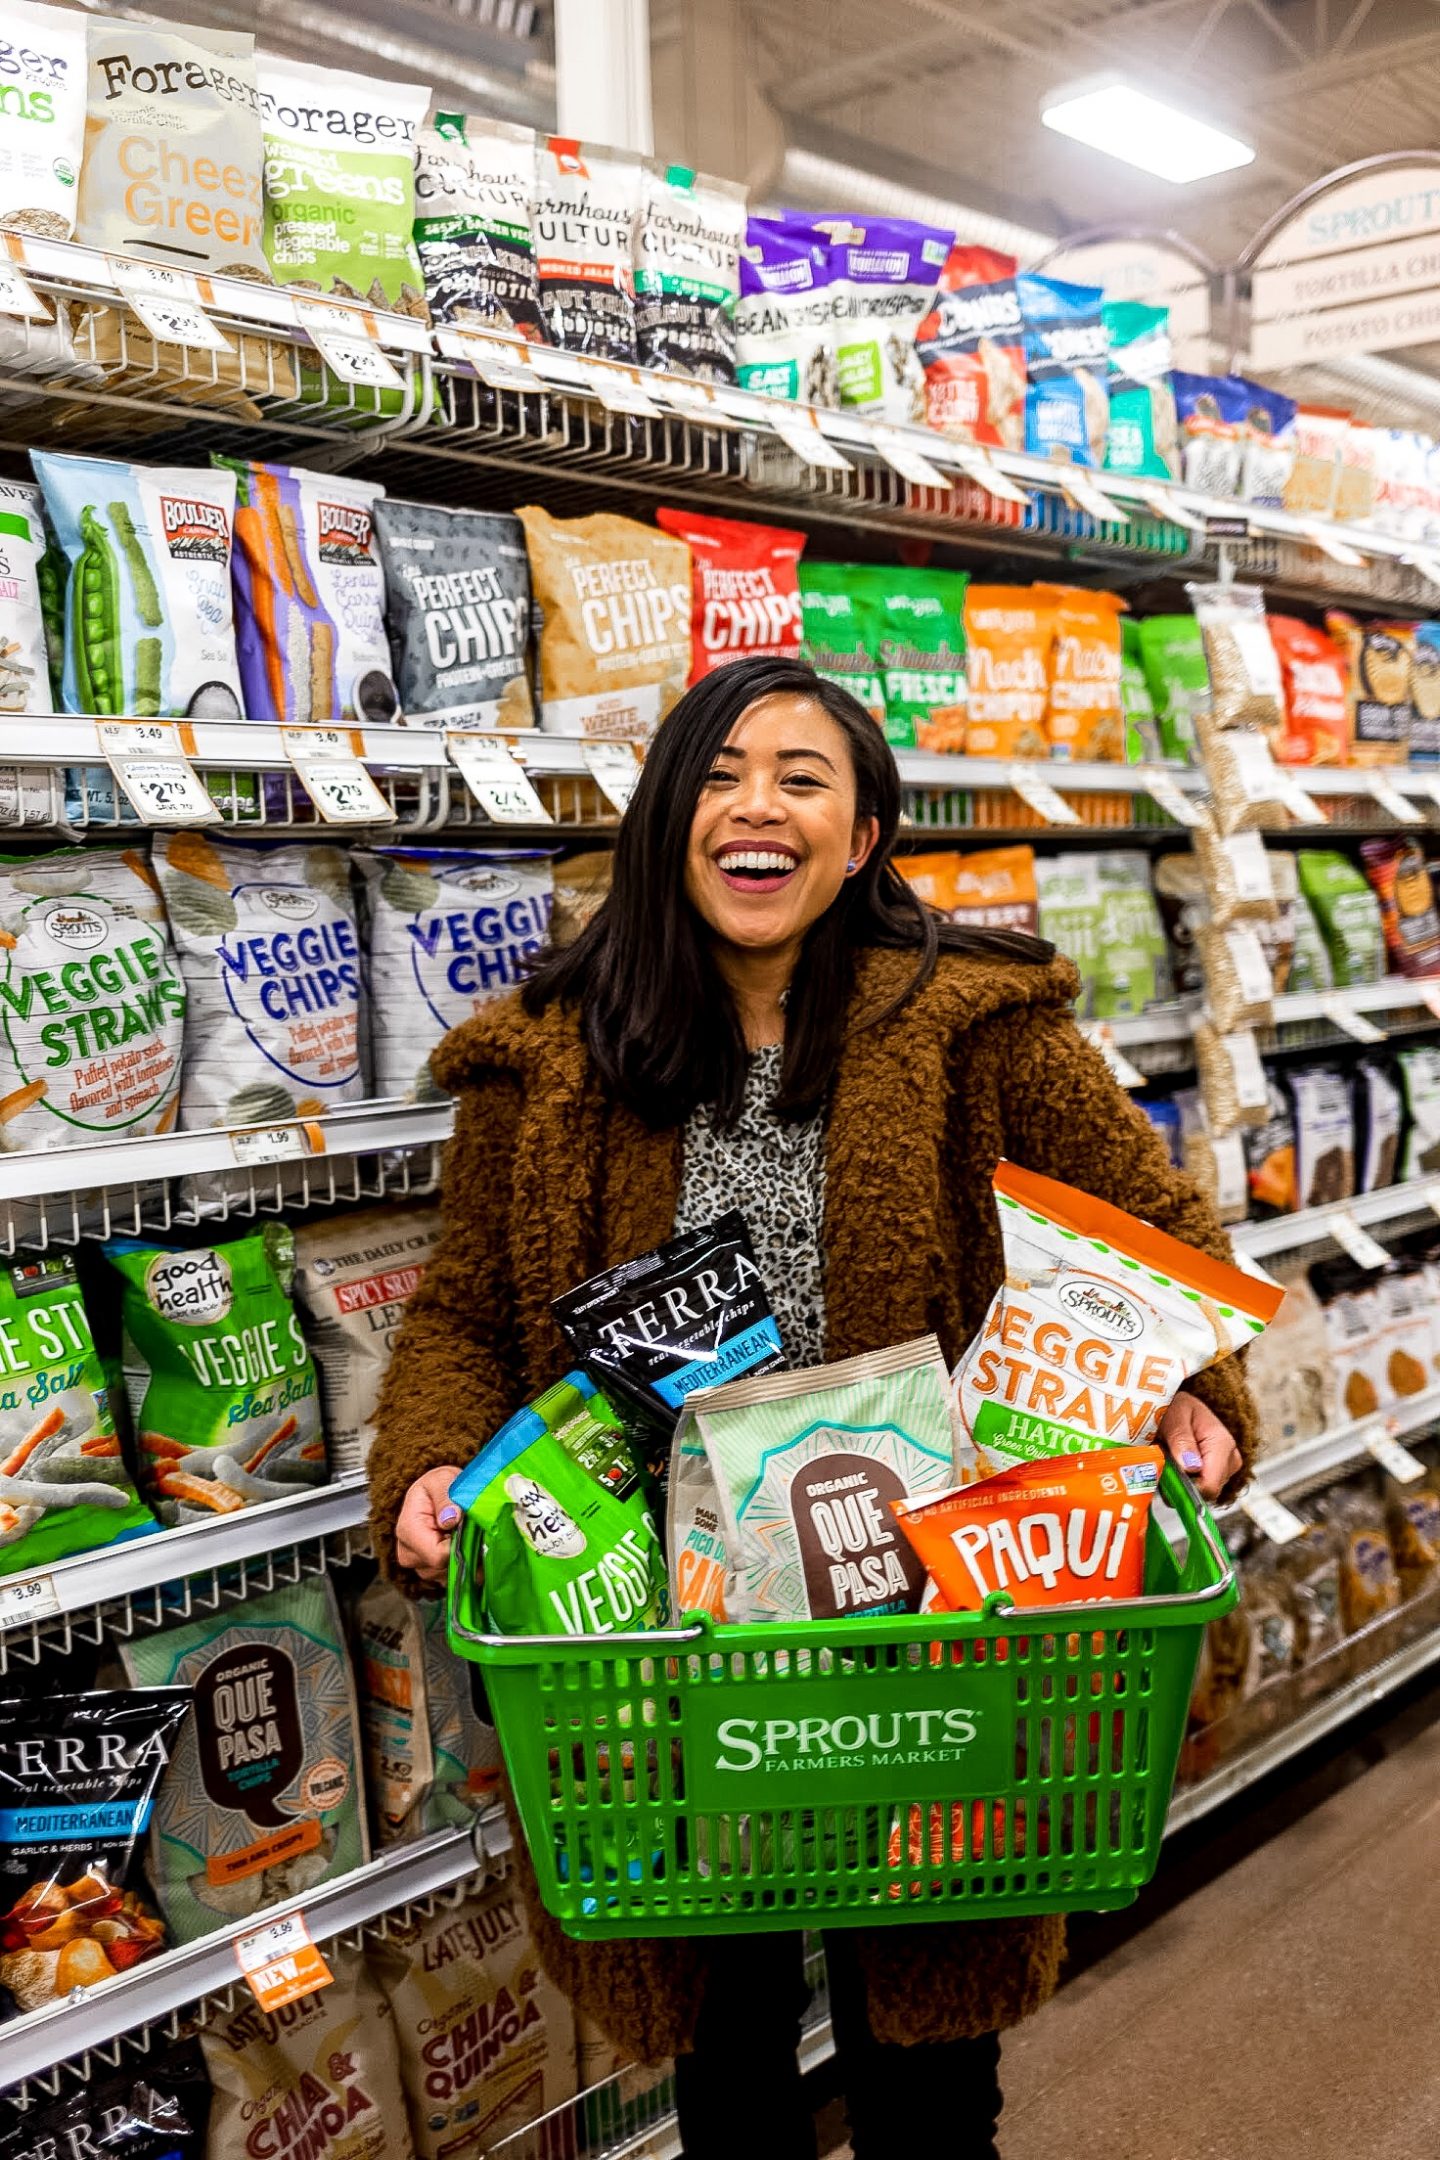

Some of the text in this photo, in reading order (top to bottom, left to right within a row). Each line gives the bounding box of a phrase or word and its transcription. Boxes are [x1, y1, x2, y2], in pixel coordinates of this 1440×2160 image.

[97, 55, 260, 111] Forager
[259, 92, 416, 144] Forager
[265, 159, 405, 206] greens
[271, 201, 357, 225] organic
[274, 221, 337, 237] pressed
[1307, 188, 1440, 245] SPROUT
[274, 233, 351, 254] vegetable
[539, 220, 629, 251] ULTUR
[272, 251, 317, 266] chips
[163, 500, 230, 539] BOULDER
[319, 505, 372, 545] BOULDER
[412, 566, 504, 611] PERFECT
[571, 558, 657, 600] PERFECT
[702, 567, 777, 600] PERFECT
[582, 584, 690, 655] CHIPS
[51, 920, 103, 940] SPROUTS
[215, 919, 358, 984] VEGGIE
[0, 936, 161, 1023] VEGGIE
[260, 964, 361, 1023] CHIPS
[40, 979, 187, 1068] STRAWS
[75, 1058, 110, 1089] Puffed
[110, 1050, 142, 1073] potato
[69, 1084, 113, 1113] flavored
[114, 1070, 136, 1093] with
[105, 1082, 161, 1119] and spinach
[152, 1251, 220, 1292] good
[334, 1251, 364, 1269] THE
[362, 1240, 406, 1263] DAILY
[157, 1273, 234, 1312] health
[340, 1279, 385, 1312] SPICY
[597, 1252, 763, 1360] TERRA
[1063, 1289, 1137, 1334] SPROUTS
[674, 1316, 723, 1352] egetable
[723, 1299, 755, 1322] chips
[177, 1319, 286, 1388] VEGGIE
[674, 1328, 773, 1395] MEDITERRANEAN
[27, 1361, 86, 1411] Salt
[227, 1374, 316, 1428] Sea Salt
[992, 1431, 1023, 1453] Green
[1007, 1413, 1105, 1455] HATCH
[806, 1471, 869, 1498] ORGANIC
[940, 1494, 995, 1514] ARTIFICIAL
[997, 1484, 1068, 1503] INGREDIENTS
[685, 1528, 716, 1556] PICO
[693, 1516, 719, 1534] SOME
[809, 1487, 895, 1562] QUE
[548, 1528, 651, 1636] VEGGIE
[828, 1549, 910, 1610] PASA
[215, 1658, 270, 1683] ORGANIC
[212, 1671, 278, 1733] QUE
[217, 1720, 283, 1771] PASA
[715, 1708, 978, 1772] SPROUTS
[764, 1748, 966, 1773] FARMERS MARKET
[226, 1757, 282, 1783] TORTILLA
[15, 1808, 135, 1834] MEDITERRANEAN
[11, 1845, 49, 1857] GARLIC
[60, 1842, 94, 1854] HERBS
[422, 1899, 521, 1973] LATE JULY
[251, 1957, 300, 1994] NEW
[416, 1995, 474, 2036] Organic
[421, 1985, 517, 2069] CHIA
[327, 2051, 357, 2082] &
[425, 2000, 543, 2100] QUINOA
[246, 2070, 331, 2160] CHIA
